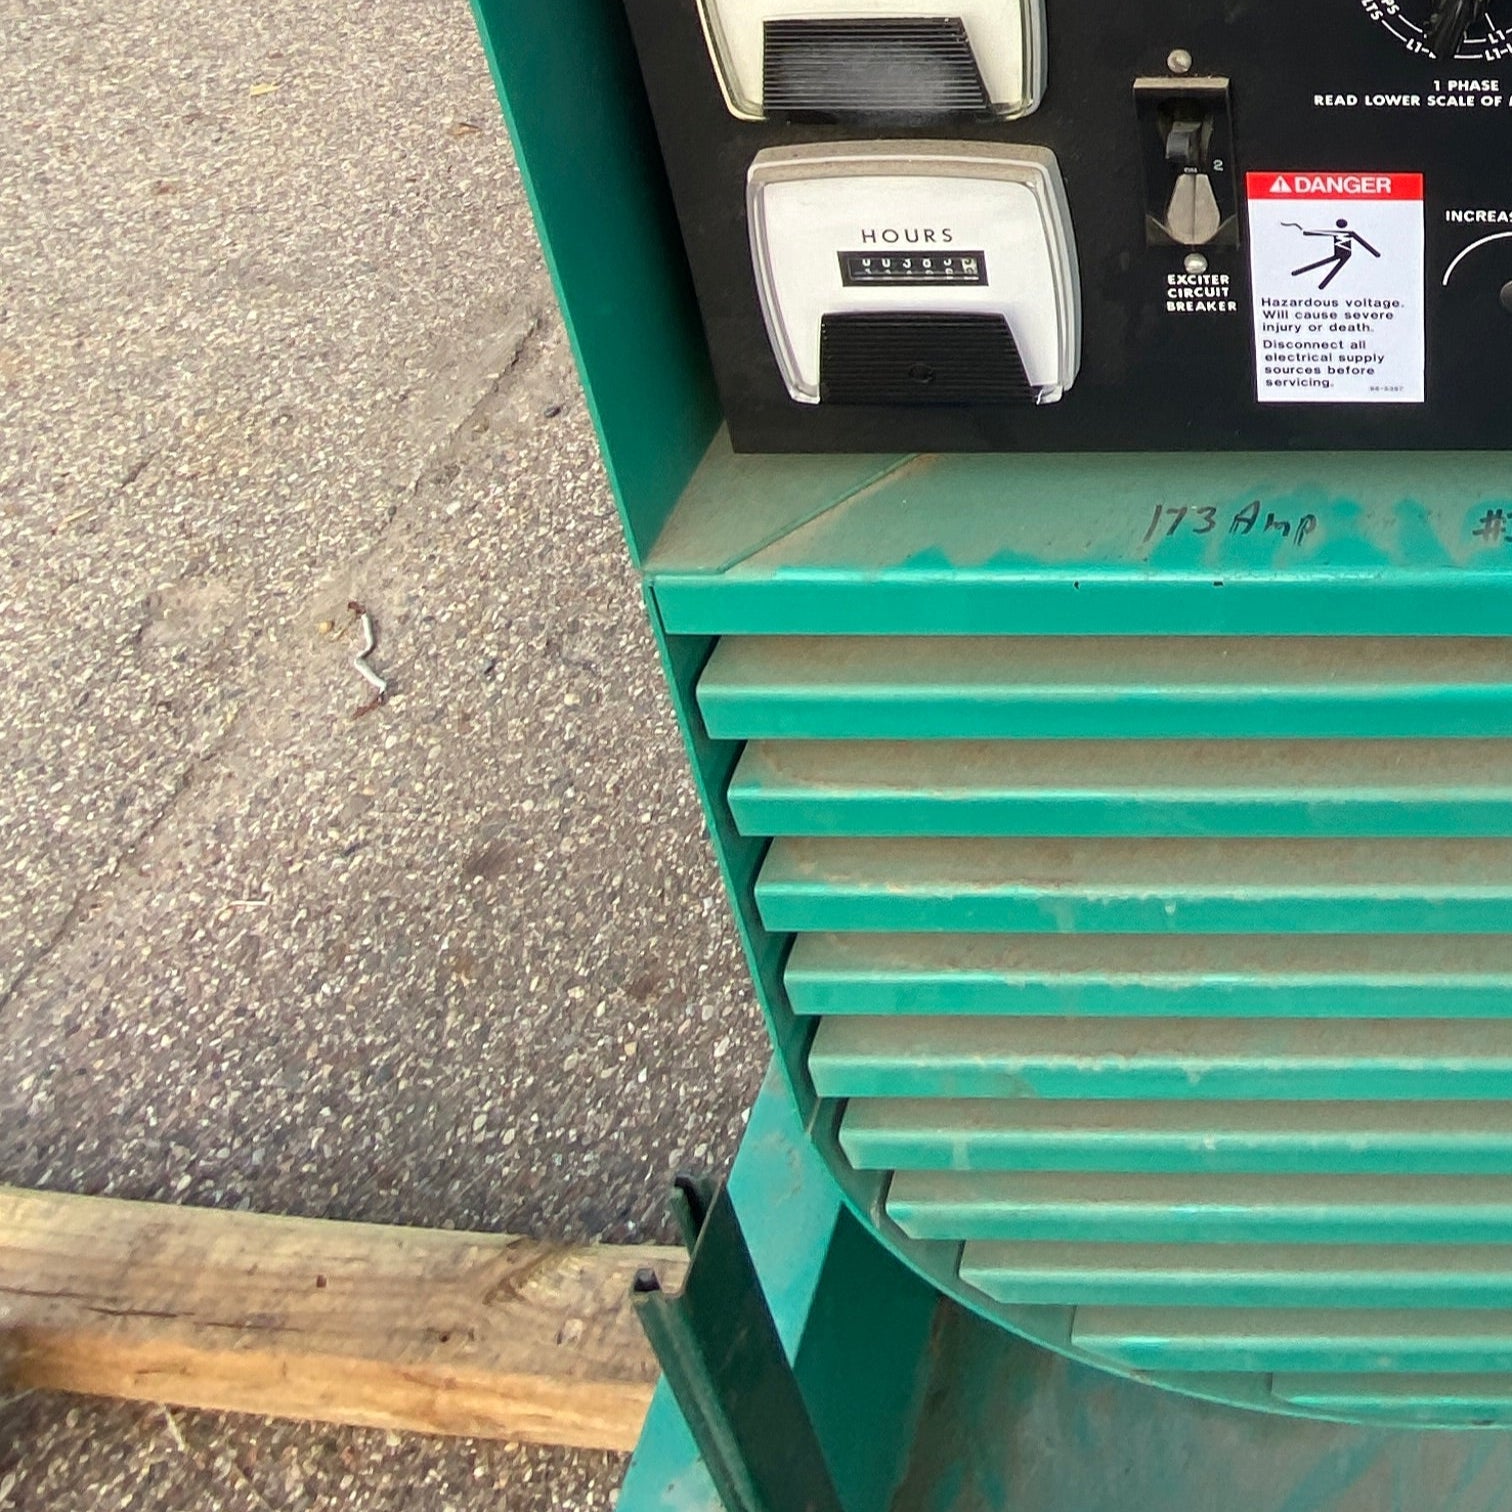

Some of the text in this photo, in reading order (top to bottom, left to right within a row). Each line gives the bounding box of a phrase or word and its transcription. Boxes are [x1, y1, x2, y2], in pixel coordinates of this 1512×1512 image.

[1488, 30, 1506, 45] L1
[1433, 80, 1499, 91] 1 PHASE
[1314, 95, 1358, 106] READ
[1365, 95, 1420, 106] LOWER
[1427, 95, 1475, 107] SCALE
[1481, 95, 1502, 107] OF
[1213, 159, 1224, 171] 2
[1295, 177, 1391, 194] DANGER
[861, 228, 953, 244] HOURS
[1167, 274, 1229, 285] EXCITER
[1167, 287, 1229, 299] CIRCUIT
[1167, 301, 1238, 312] BREAKER
[1261, 298, 1404, 309] Hazardous voltage.
[1263, 310, 1394, 320] Will cause severe
[1262, 323, 1301, 333] injury
[1329, 323, 1374, 332] death.
[1263, 340, 1366, 349] Disconnect all
[1265, 353, 1384, 364] electrical supply
[1265, 365, 1375, 375] sources before
[1266, 378, 1334, 388] servicing.
[1143, 504, 1217, 543] 173
